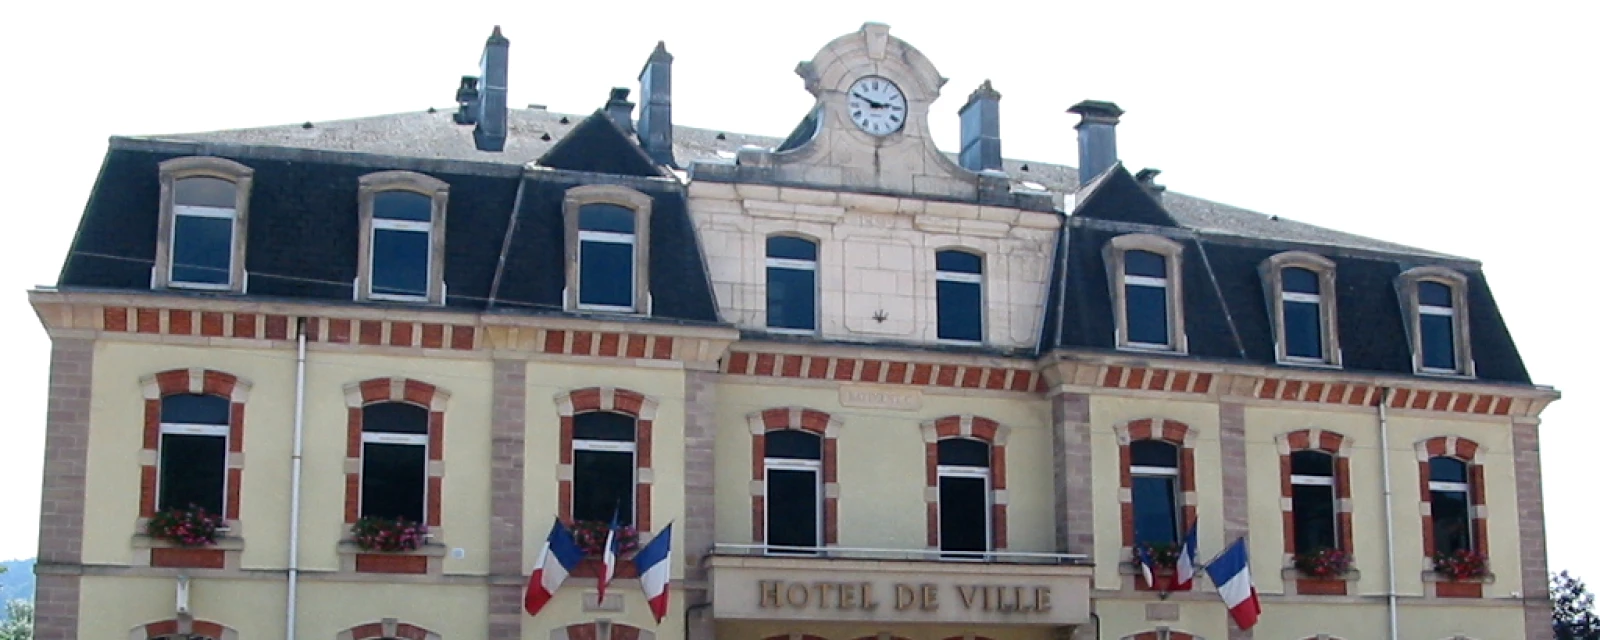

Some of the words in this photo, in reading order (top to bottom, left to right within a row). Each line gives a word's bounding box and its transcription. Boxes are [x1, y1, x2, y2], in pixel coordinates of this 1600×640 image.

[758, 580, 879, 610] HOTEL
[894, 583, 939, 611] DE
[955, 585, 1052, 613] VILLE
